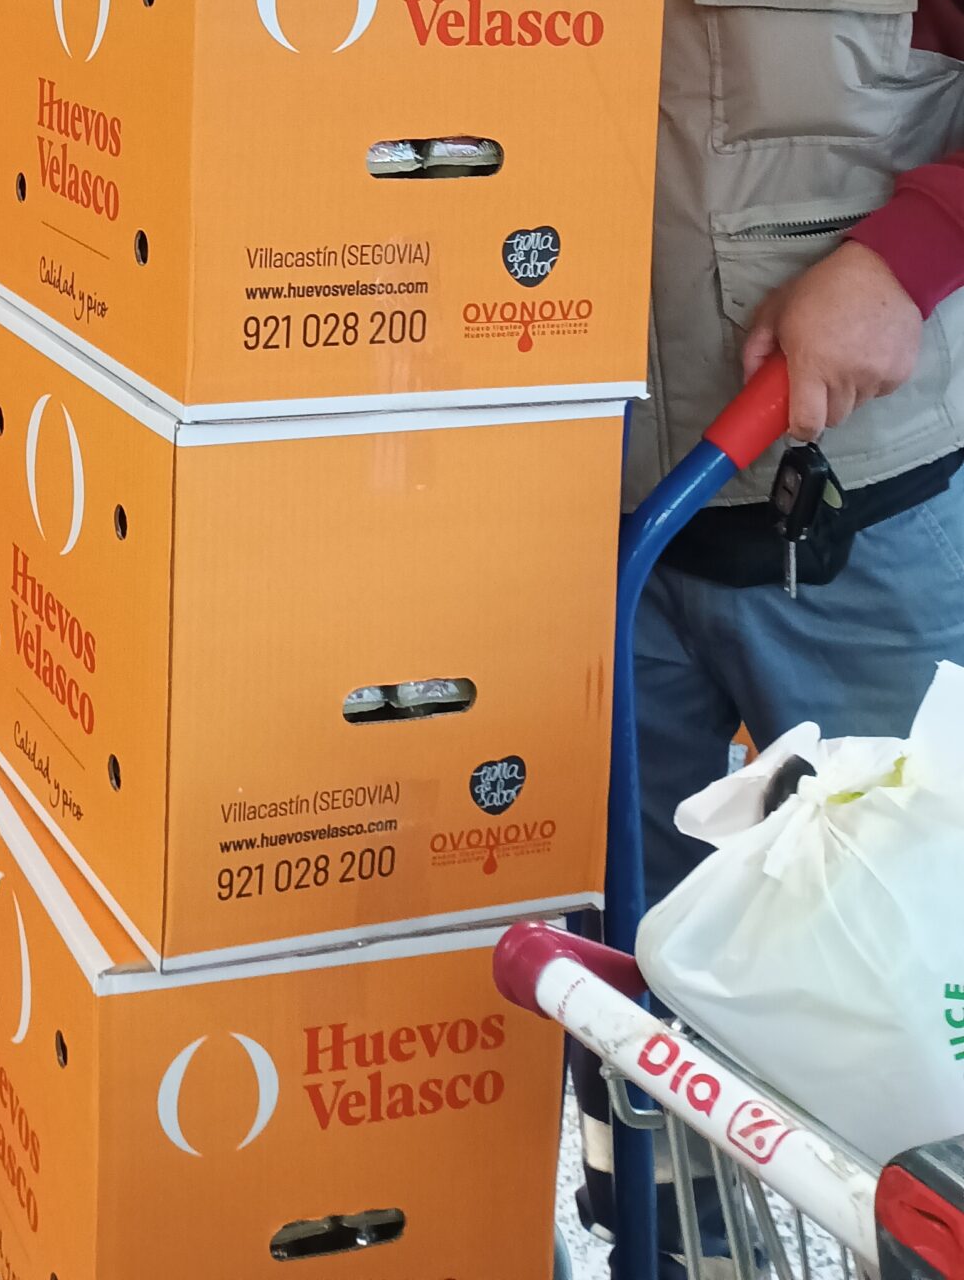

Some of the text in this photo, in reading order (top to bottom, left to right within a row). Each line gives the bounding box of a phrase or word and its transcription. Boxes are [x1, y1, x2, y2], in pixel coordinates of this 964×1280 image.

[37, 77, 122, 157] Huevos
[37, 135, 119, 221] Velasco
[246, 242, 431, 270] Villacastín (SEGOVIA)
[39, 256, 76, 302] Calidad
[74, 289, 85, 320] y
[245, 280, 429, 300] www.huevosvelasco.com
[462, 299, 593, 324] OVONOVO
[243, 309, 427, 350] 921 028 200
[10, 542, 97, 674] Huevos
[10, 599, 96, 735] Velasco
[13, 721, 52, 787] Calidad
[221, 781, 400, 823] Villacastín (SEGOVIA)
[219, 817, 398, 853] www.huevosvelasco.com
[430, 819, 556, 853] OVONOVO
[217, 845, 396, 901] 921 028 200
[303, 1013, 506, 1075] Huevos
[303, 1069, 506, 1131] Velasco
